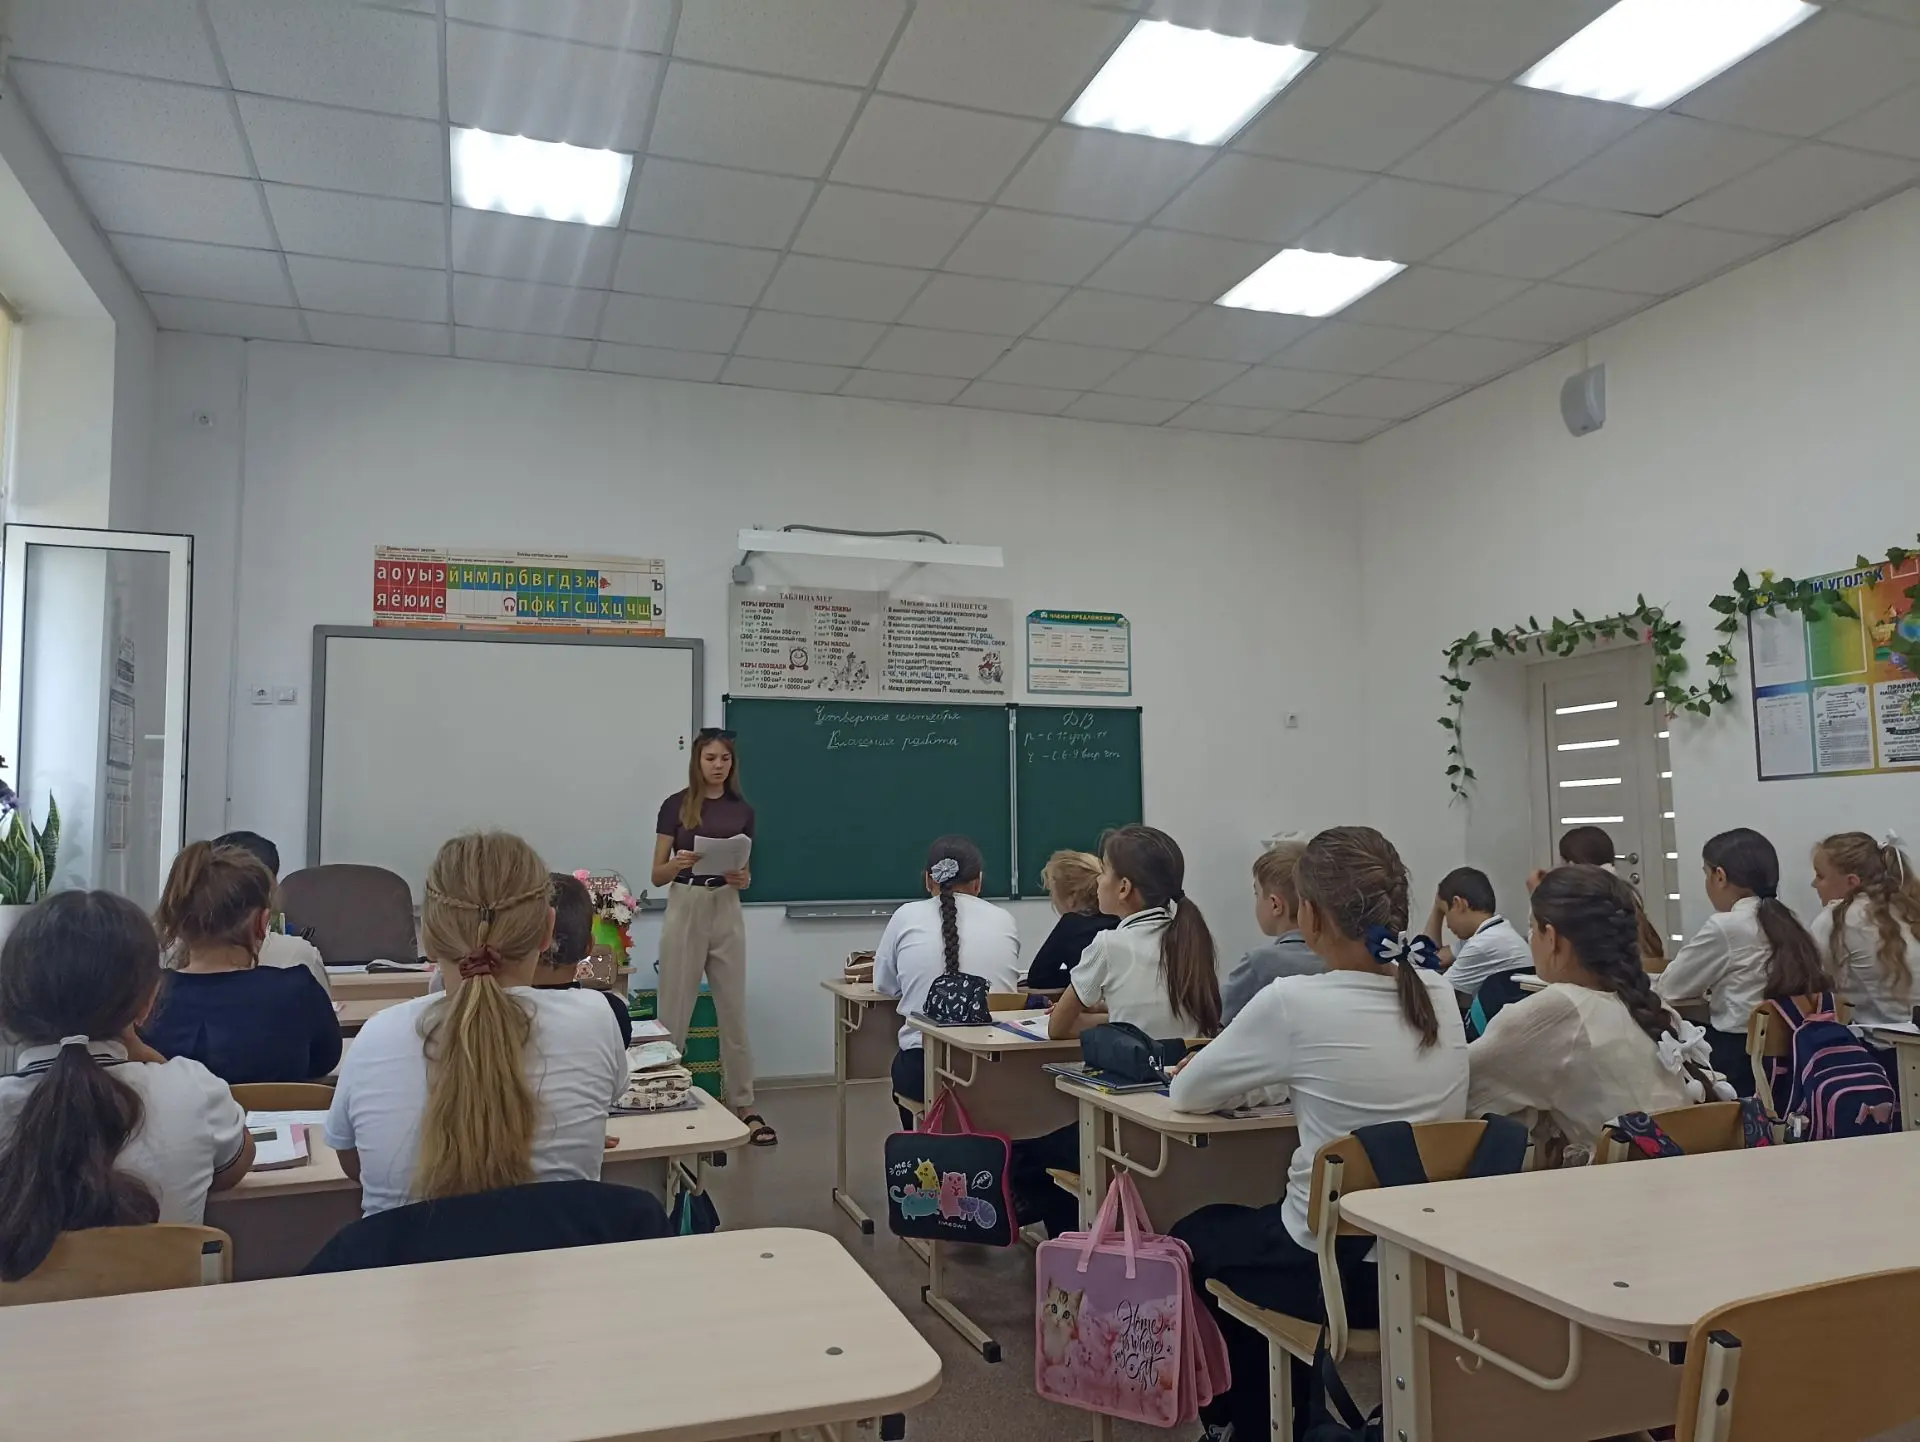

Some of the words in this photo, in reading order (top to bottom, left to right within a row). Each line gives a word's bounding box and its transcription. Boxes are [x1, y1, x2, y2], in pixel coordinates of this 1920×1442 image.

[780, 593, 814, 602] ТАБЛИЦА
[1888, 682, 1920, 690] ПРАВИЛ
[1117, 1300, 1164, 1336] Home
[1126, 1353, 1165, 1387] Cat
